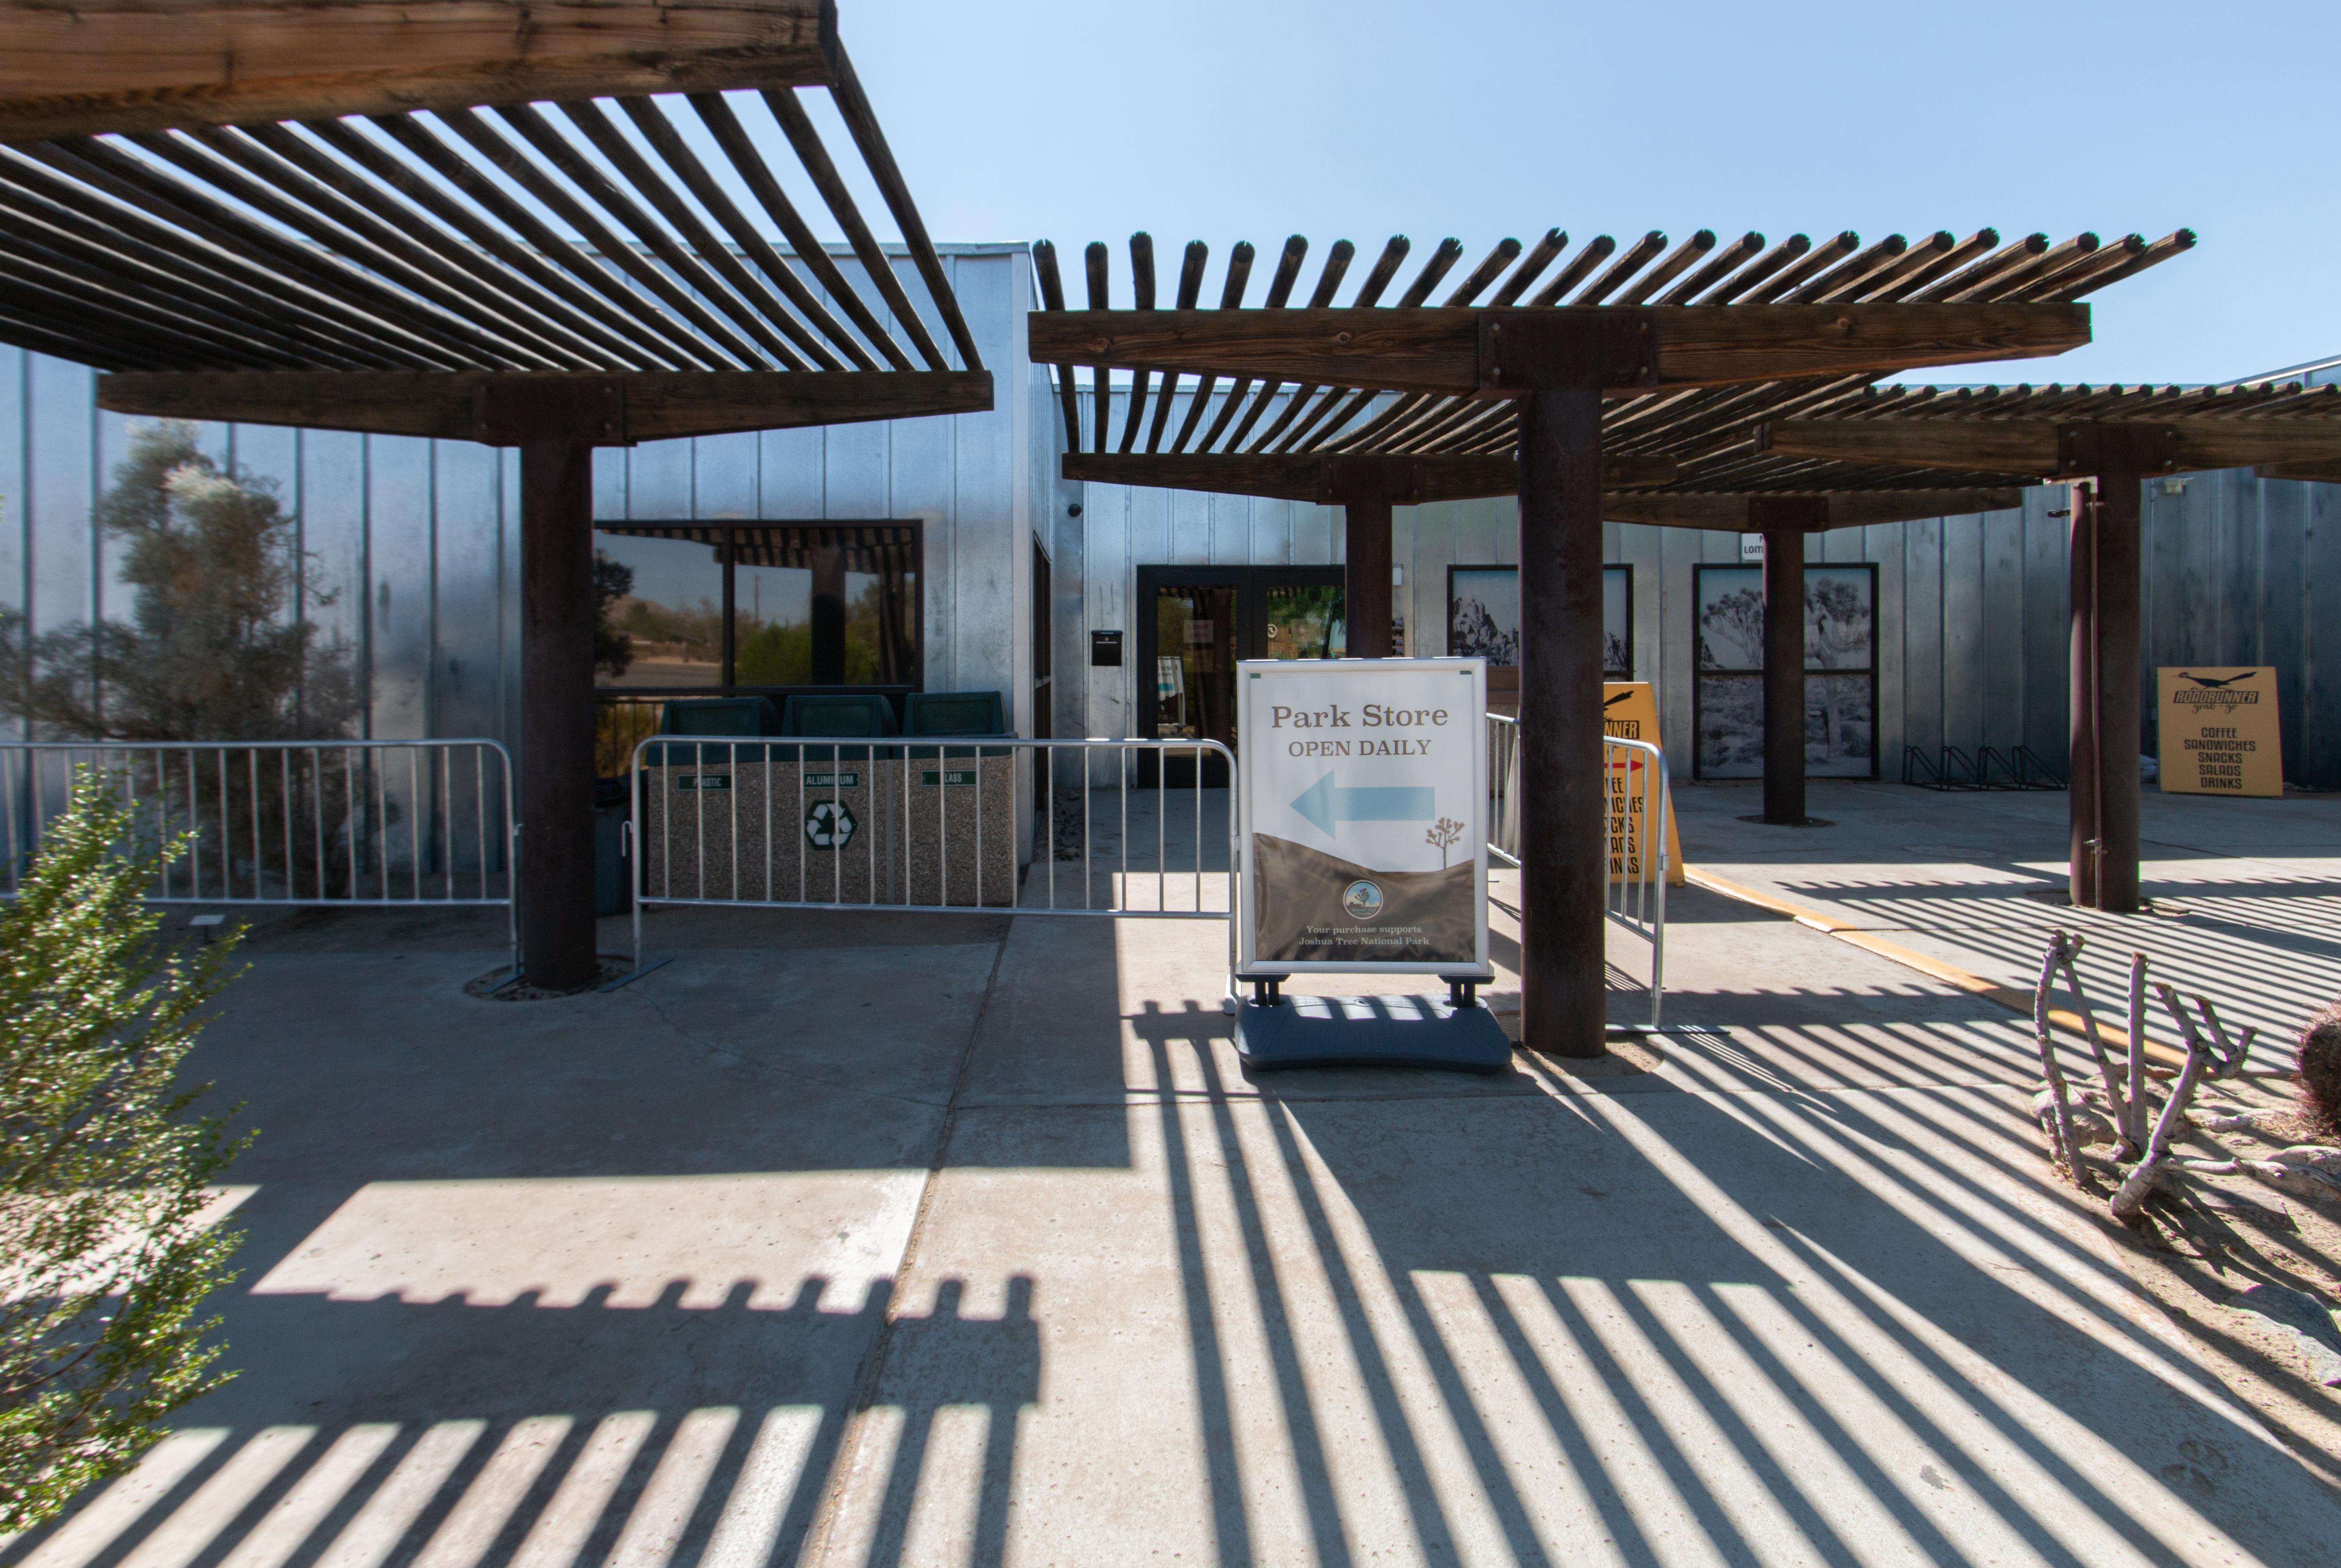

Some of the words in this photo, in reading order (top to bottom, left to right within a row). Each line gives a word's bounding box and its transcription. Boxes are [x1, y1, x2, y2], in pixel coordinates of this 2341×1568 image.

[2175, 691, 2258, 703] ROADRUNNER
[2192, 703, 2216, 714] grab
[2224, 703, 2238, 714] go
[1271, 704, 1351, 728] Park
[1363, 704, 1448, 727] Store
[2201, 727, 2237, 738] COFFEE
[1288, 741, 1351, 757] OPEN
[1358, 739, 1432, 756] DAILY
[2184, 739, 2256, 751] SANDWICHES
[2198, 751, 2242, 764] SNACKS
[2199, 764, 2241, 777] SALADS
[693, 777, 722, 787] PASTIC
[806, 775, 854, 785] ALUMIUM
[944, 773, 962, 782] LASS
[2201, 777, 2242, 789] DRINKS
[1306, 926, 1330, 934] Your
[1332, 926, 1377, 935] purchase
[1379, 926, 1422, 935] supports
[1299, 937, 1333, 945] Joshua
[1361, 937, 1403, 945] National
[1405, 937, 1430, 945] Park
